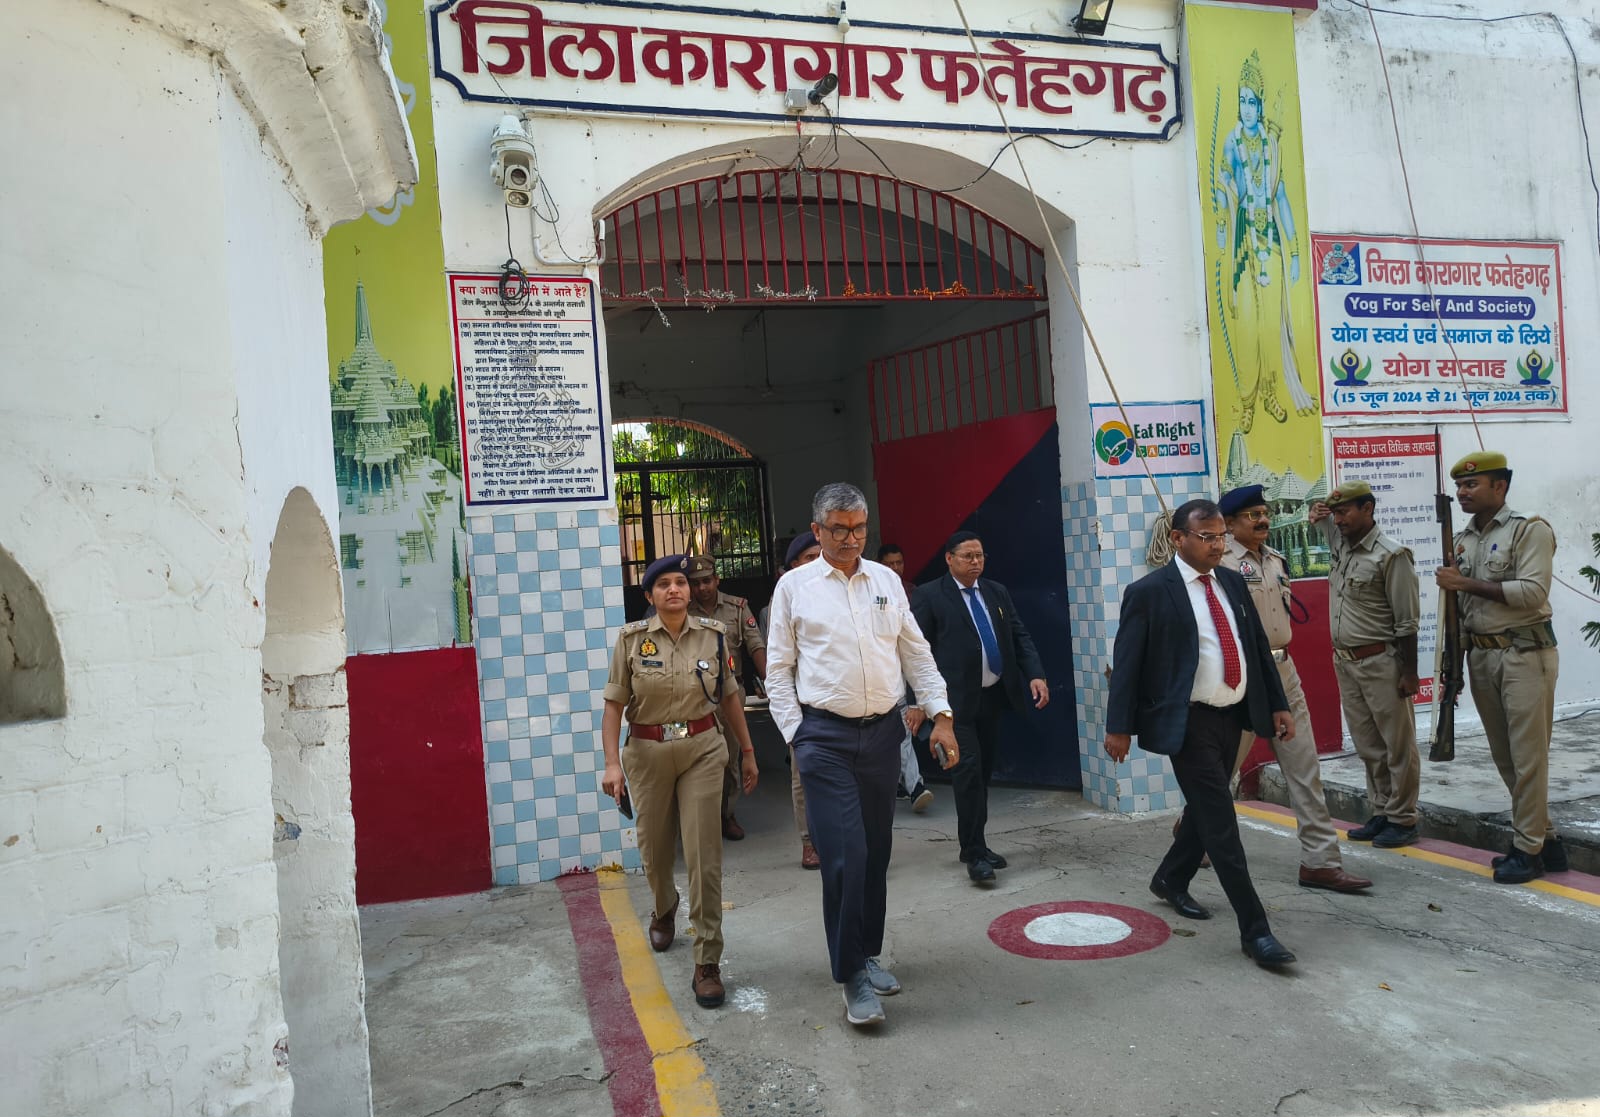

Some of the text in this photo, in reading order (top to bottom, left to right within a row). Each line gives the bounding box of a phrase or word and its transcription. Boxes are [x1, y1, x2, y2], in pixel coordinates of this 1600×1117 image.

[450, 1, 1166, 124] जिला कारागार फतेहगढ़
[1366, 248, 1550, 296] जिला कारागार फतेहगढ़
[459, 286, 475, 296] क्या
[480, 288, 498, 296] आप
[553, 286, 571, 297] आते
[1350, 297, 1531, 316] Yog For Self And Society
[1331, 322, 1367, 343] योग
[1372, 323, 1408, 343] स्वयं
[1414, 324, 1437, 345] एवं
[1442, 328, 1492, 344] समाज
[1497, 325, 1513, 344] के
[1519, 324, 1551, 344] लिये
[1383, 353, 1507, 378] योग सप्ताह
[1333, 388, 1556, 408] (15 जून 2024 से 21 जून 2024 तक)
[1134, 421, 1195, 441] Eat Right
[1136, 443, 1199, 457] CAMPUS
[1360, 441, 1369, 454] को
[1371, 443, 1386, 454] प्राप्त
[1388, 440, 1410, 453] विधिक
